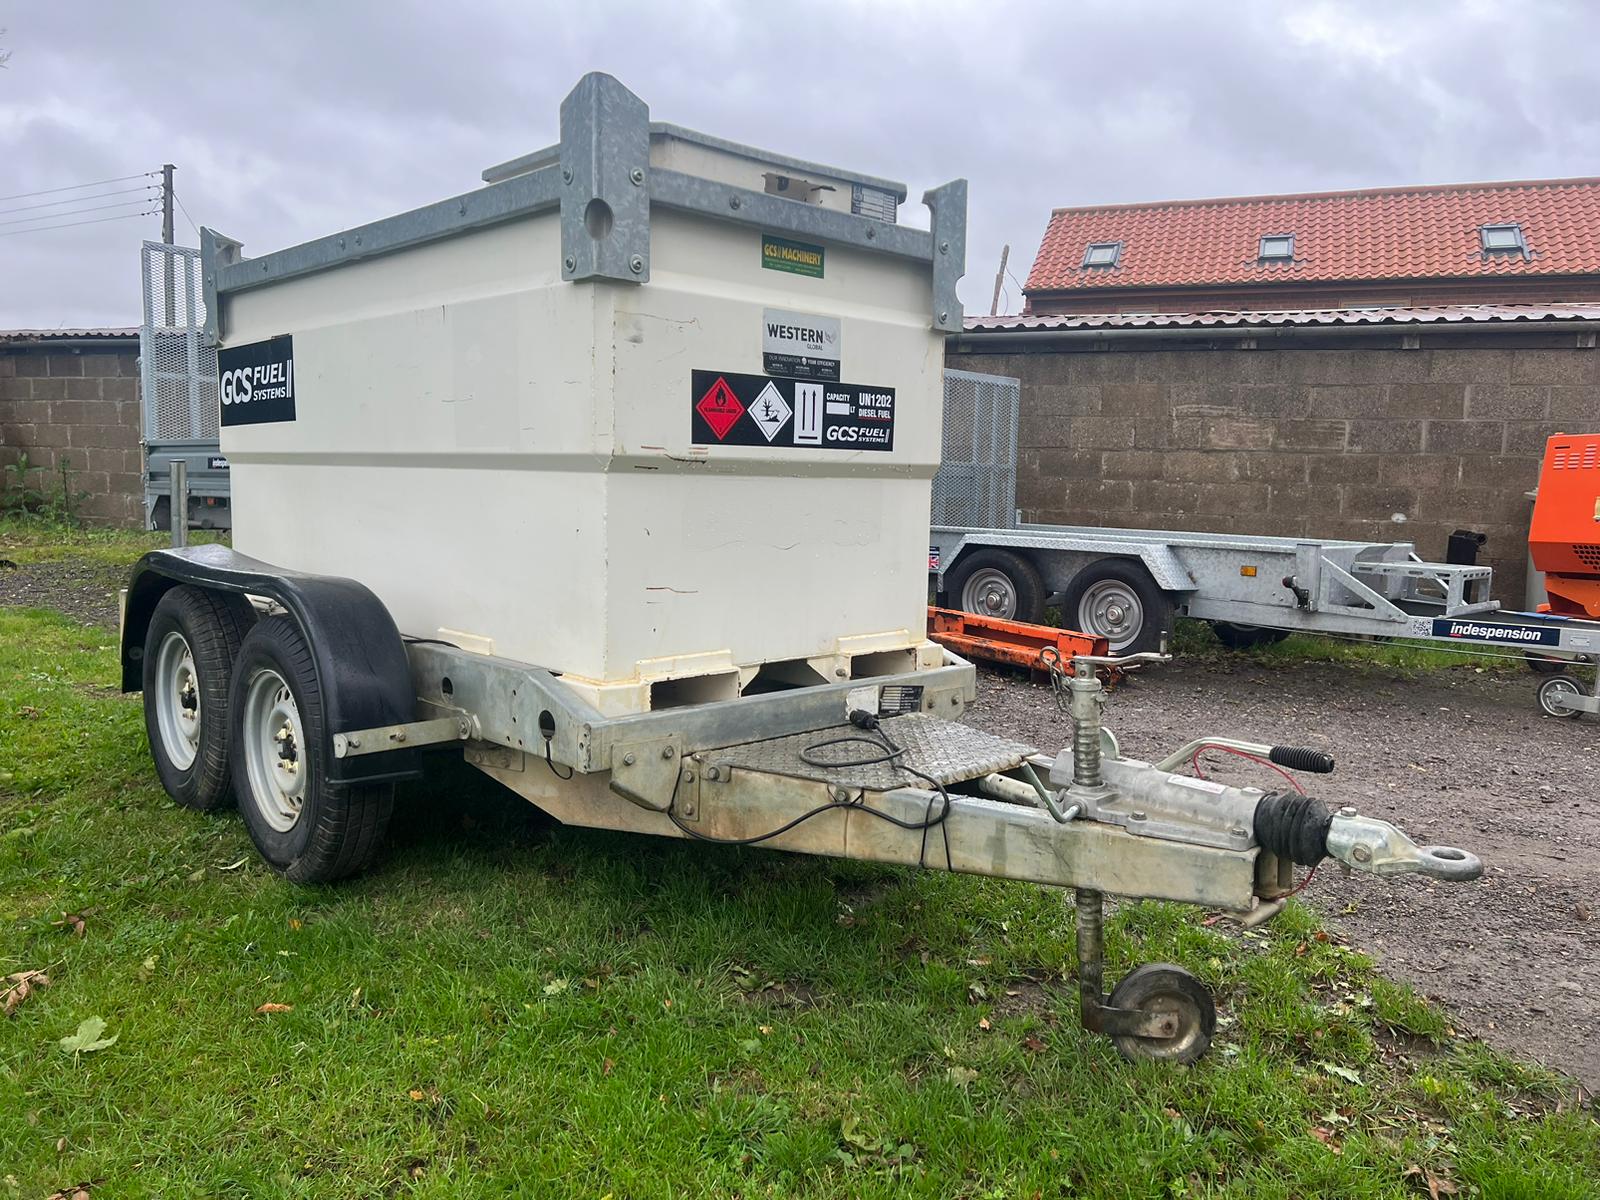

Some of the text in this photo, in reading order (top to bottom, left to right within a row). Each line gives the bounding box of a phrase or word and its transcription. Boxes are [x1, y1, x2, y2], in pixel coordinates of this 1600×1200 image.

[764, 243, 778, 257] GCS
[782, 247, 821, 265] MACHINERY
[767, 323, 824, 343] WESTERN
[807, 343, 823, 351] GLOBAL
[221, 362, 286, 405] GCS FUEL
[253, 386, 286, 401] SYSTEMS
[826, 392, 850, 402] CAPACITY
[859, 392, 892, 408] UN1202
[858, 408, 891, 419] DIESEL FUEL
[826, 425, 885, 442] GCS FUEL
[1450, 622, 1542, 641] indespension
